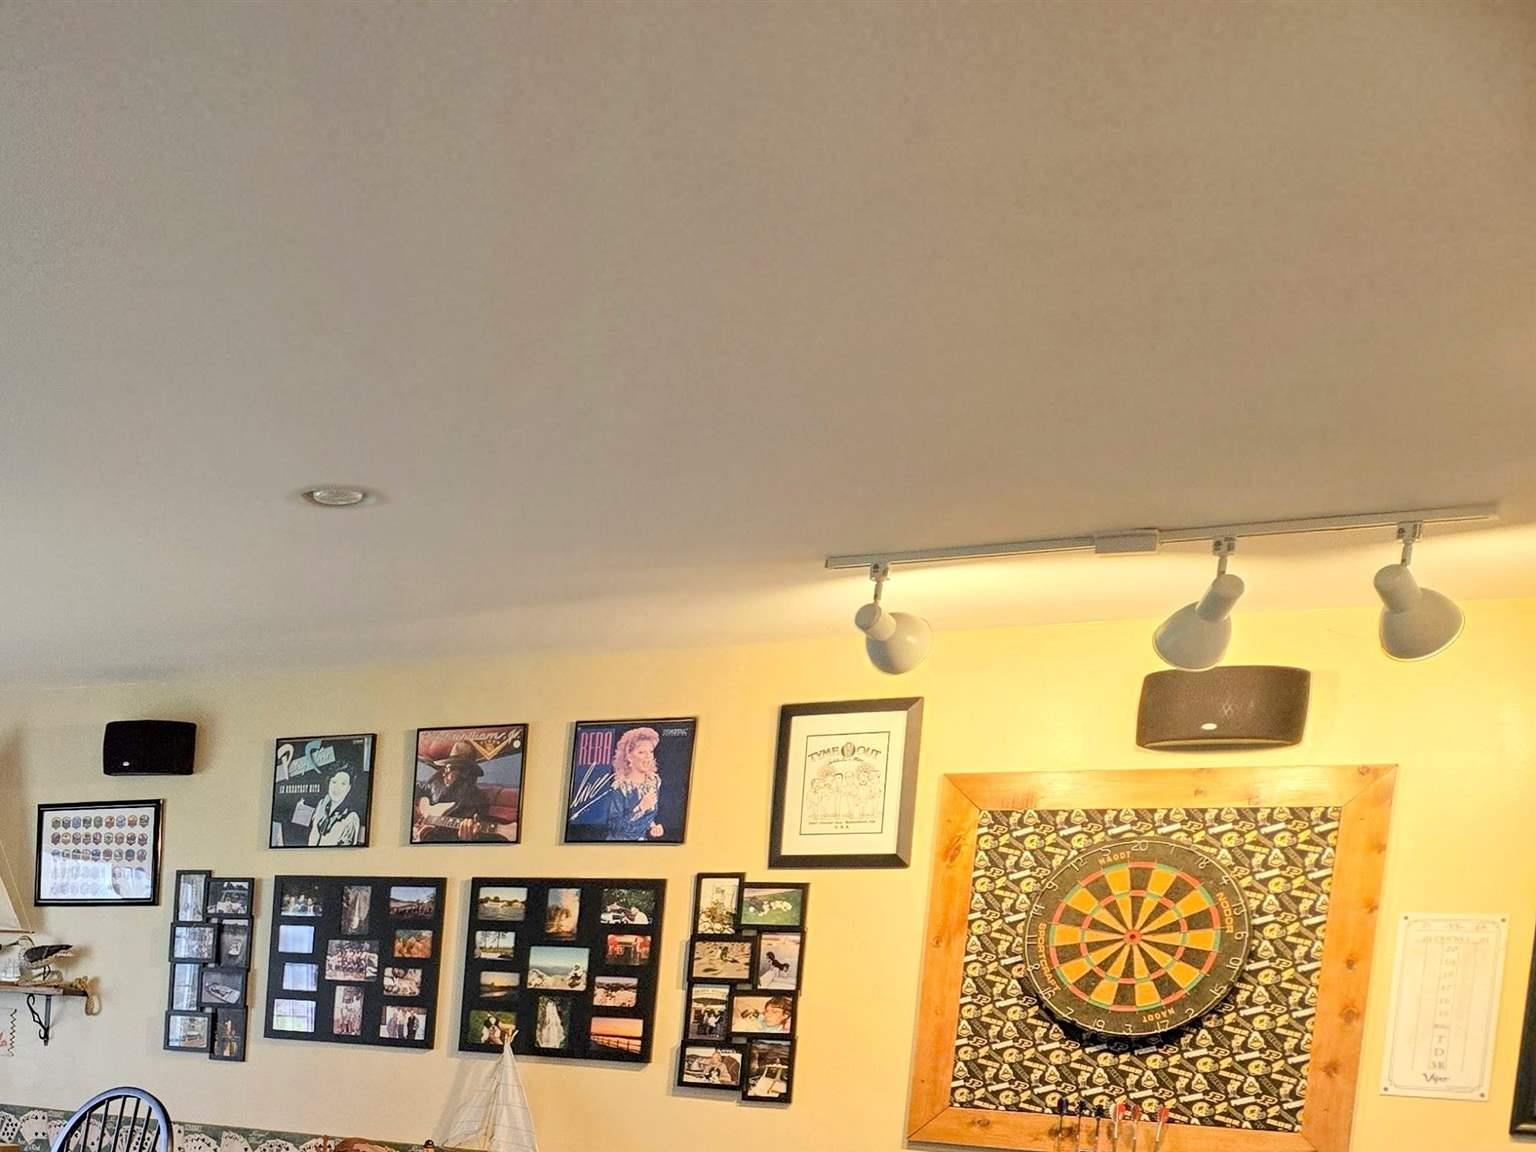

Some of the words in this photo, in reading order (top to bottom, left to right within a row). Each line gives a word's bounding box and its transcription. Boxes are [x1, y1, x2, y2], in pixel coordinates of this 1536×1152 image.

[579, 731, 613, 766] REBA
[1131, 840, 1149, 851] 20
[1069, 857, 1088, 872] 12
[1194, 857, 1210, 869] 18
[1221, 875, 1230, 886] 4
[1216, 892, 1235, 933] NODOR
[1234, 930, 1248, 940] 6
[1037, 923, 1061, 992] SPORTCRAFT
[1226, 956, 1242, 970] 10
[1210, 984, 1226, 999] 15
[1064, 1007, 1074, 1018] 7
[1185, 1008, 1195, 1018] 2
[1093, 1019, 1106, 1031] 19
[1124, 1023, 1133, 1034] 3
[1156, 1020, 1170, 1031] 17
